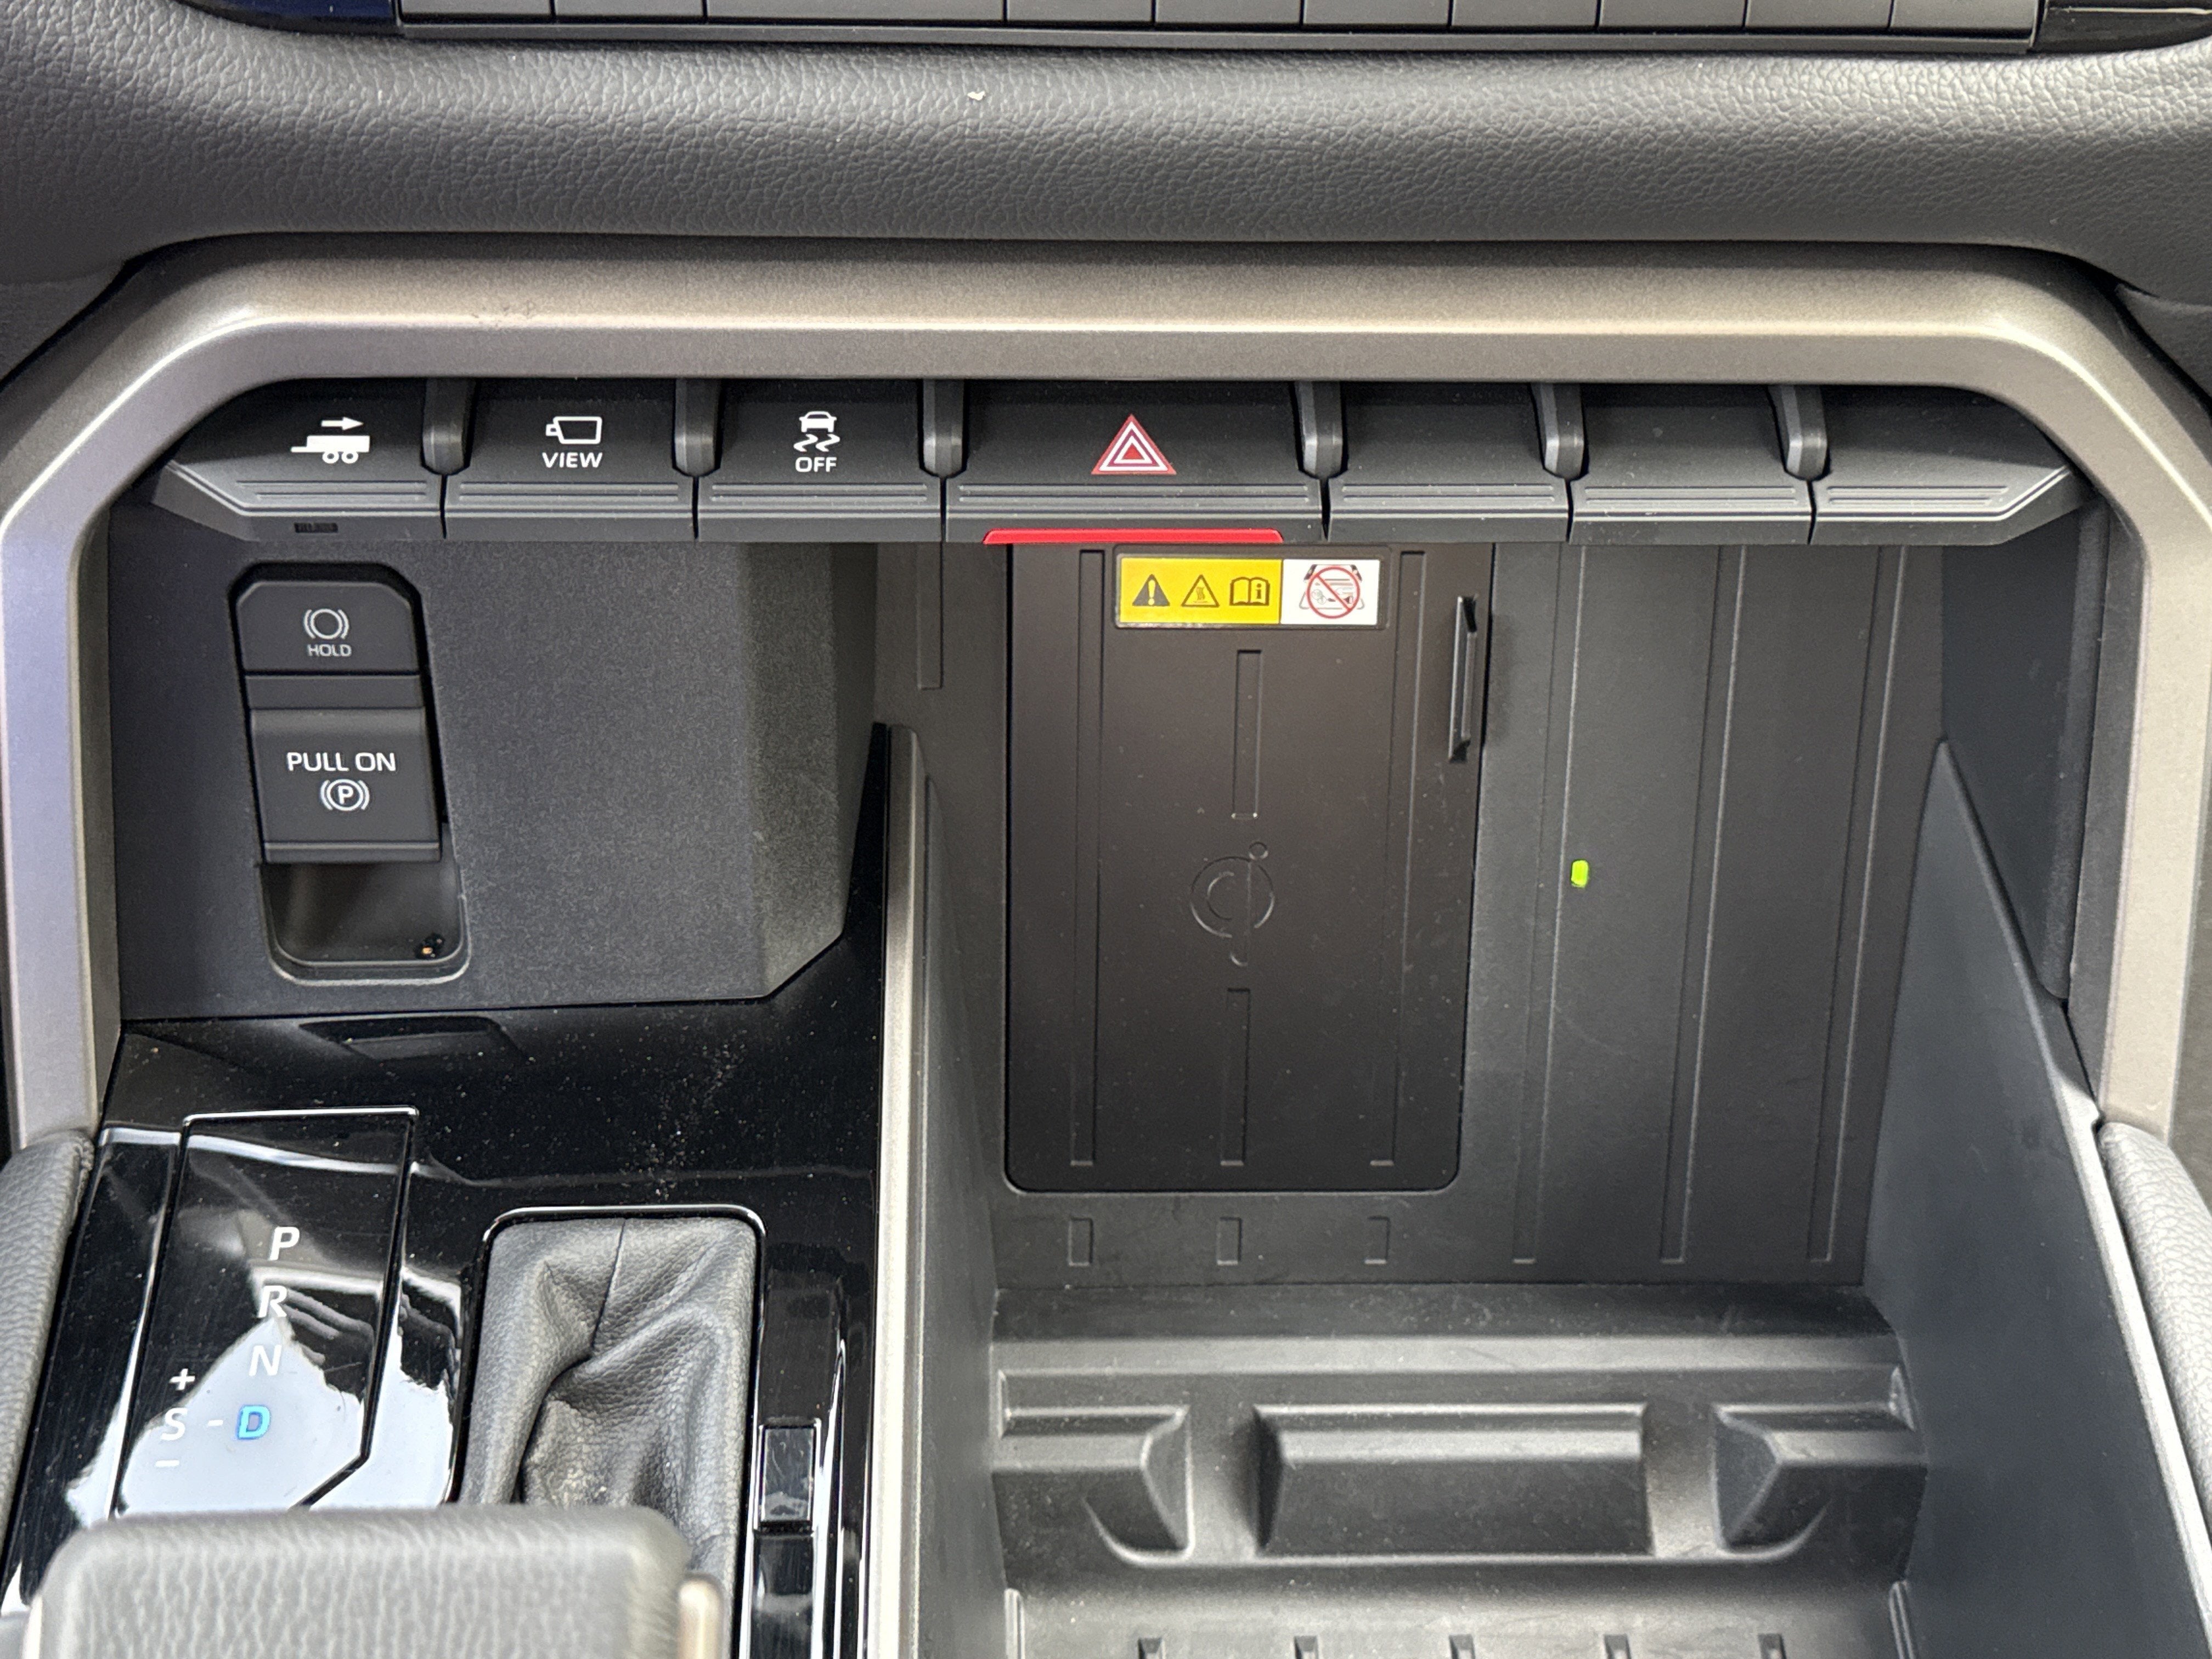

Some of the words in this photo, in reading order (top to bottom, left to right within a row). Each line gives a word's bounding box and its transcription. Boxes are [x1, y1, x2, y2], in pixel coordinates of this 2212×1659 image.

[542, 452, 603, 469] VIEW
[795, 456, 837, 472] OFF
[307, 644, 352, 657] HOLD
[287, 752, 349, 771] PULL
[355, 752, 396, 771] ON
[337, 785, 354, 804] P
[268, 1226, 300, 1261] P
[257, 1285, 287, 1318] R
[249, 1345, 283, 1377] N
[161, 1407, 188, 1441] S
[236, 1404, 271, 1440] D
